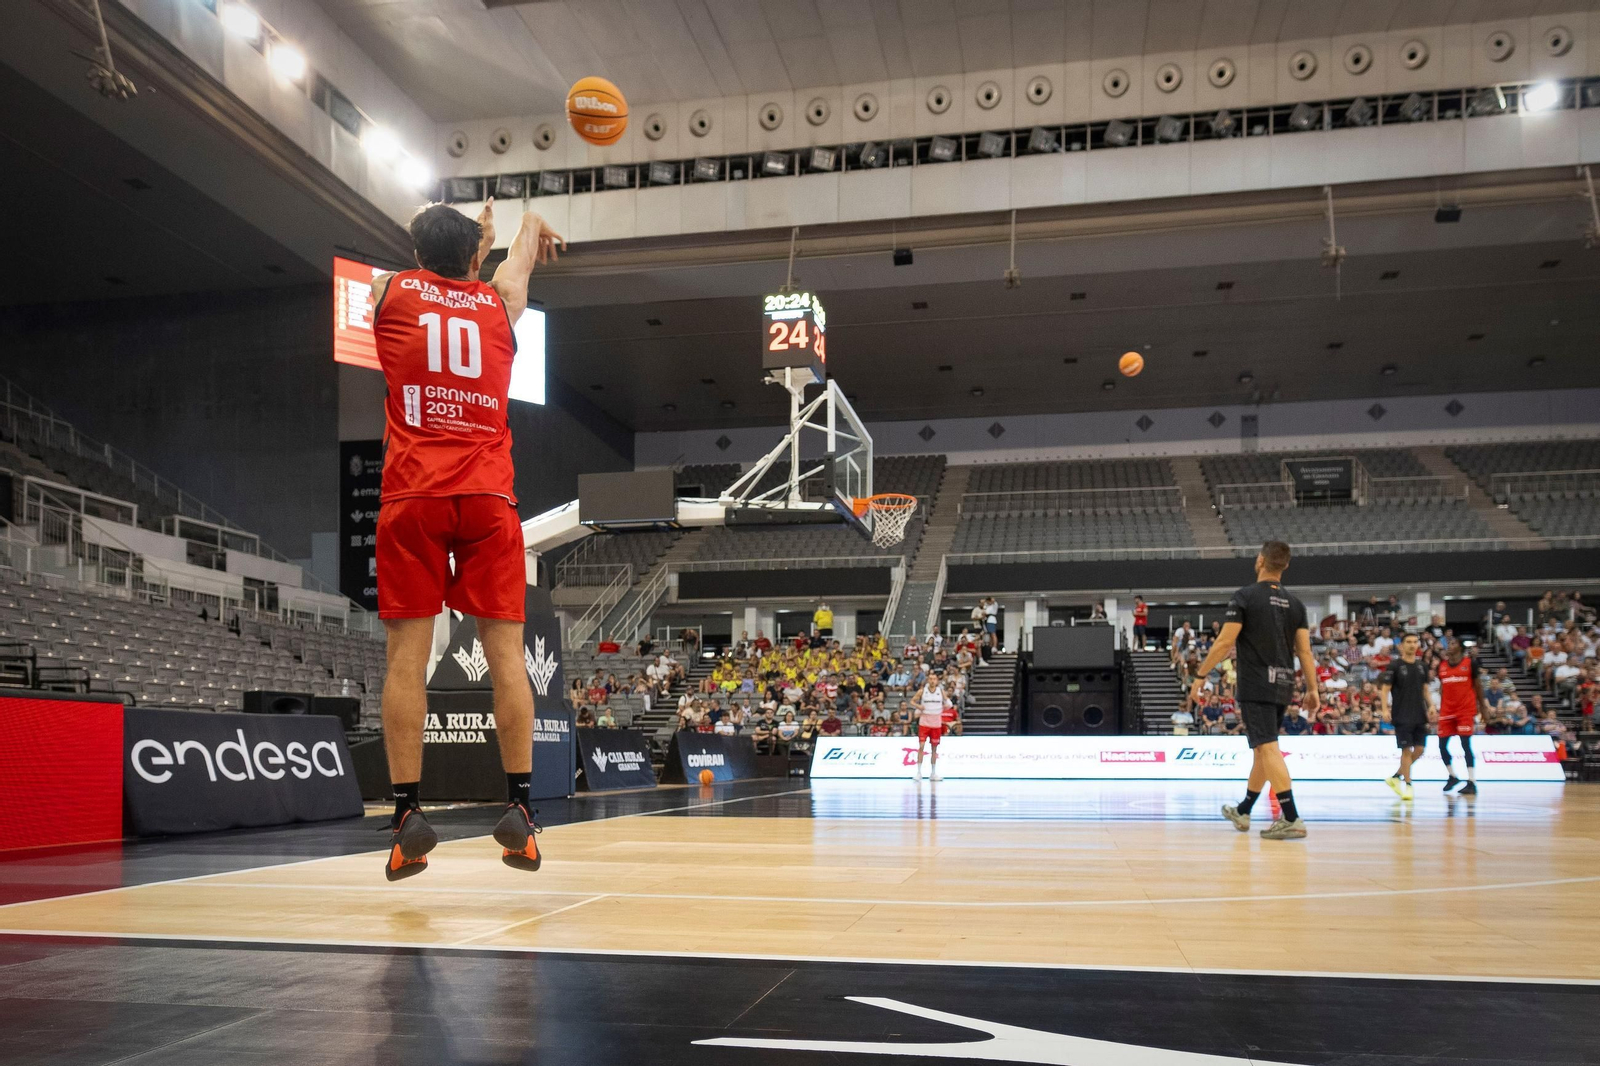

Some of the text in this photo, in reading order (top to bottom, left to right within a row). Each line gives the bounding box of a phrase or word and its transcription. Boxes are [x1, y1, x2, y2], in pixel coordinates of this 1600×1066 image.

[575, 97, 618, 113] Wilson
[400, 279, 497, 308] CAJA RURAL
[420, 292, 478, 311] GRANADA
[764, 292, 811, 310] 20:24
[769, 320, 809, 351] 24
[418, 312, 483, 379] 10
[425, 385, 499, 411] GRANADA
[426, 401, 463, 418] 2031
[423, 713, 497, 730] JA RURA
[533, 718, 570, 733] JA RURAL
[422, 731, 487, 744] GRANADA
[533, 732, 560, 742] GRANADA
[130, 728, 345, 784] endesa
[608, 752, 645, 763] CAJA RURAL
[1020, 752, 1061, 761] Seguros
[1072, 752, 1097, 760] nivel
[1101, 751, 1157, 762] Nacional
[1484, 751, 1548, 762] Nacional
[618, 762, 640, 771] GRANADA
